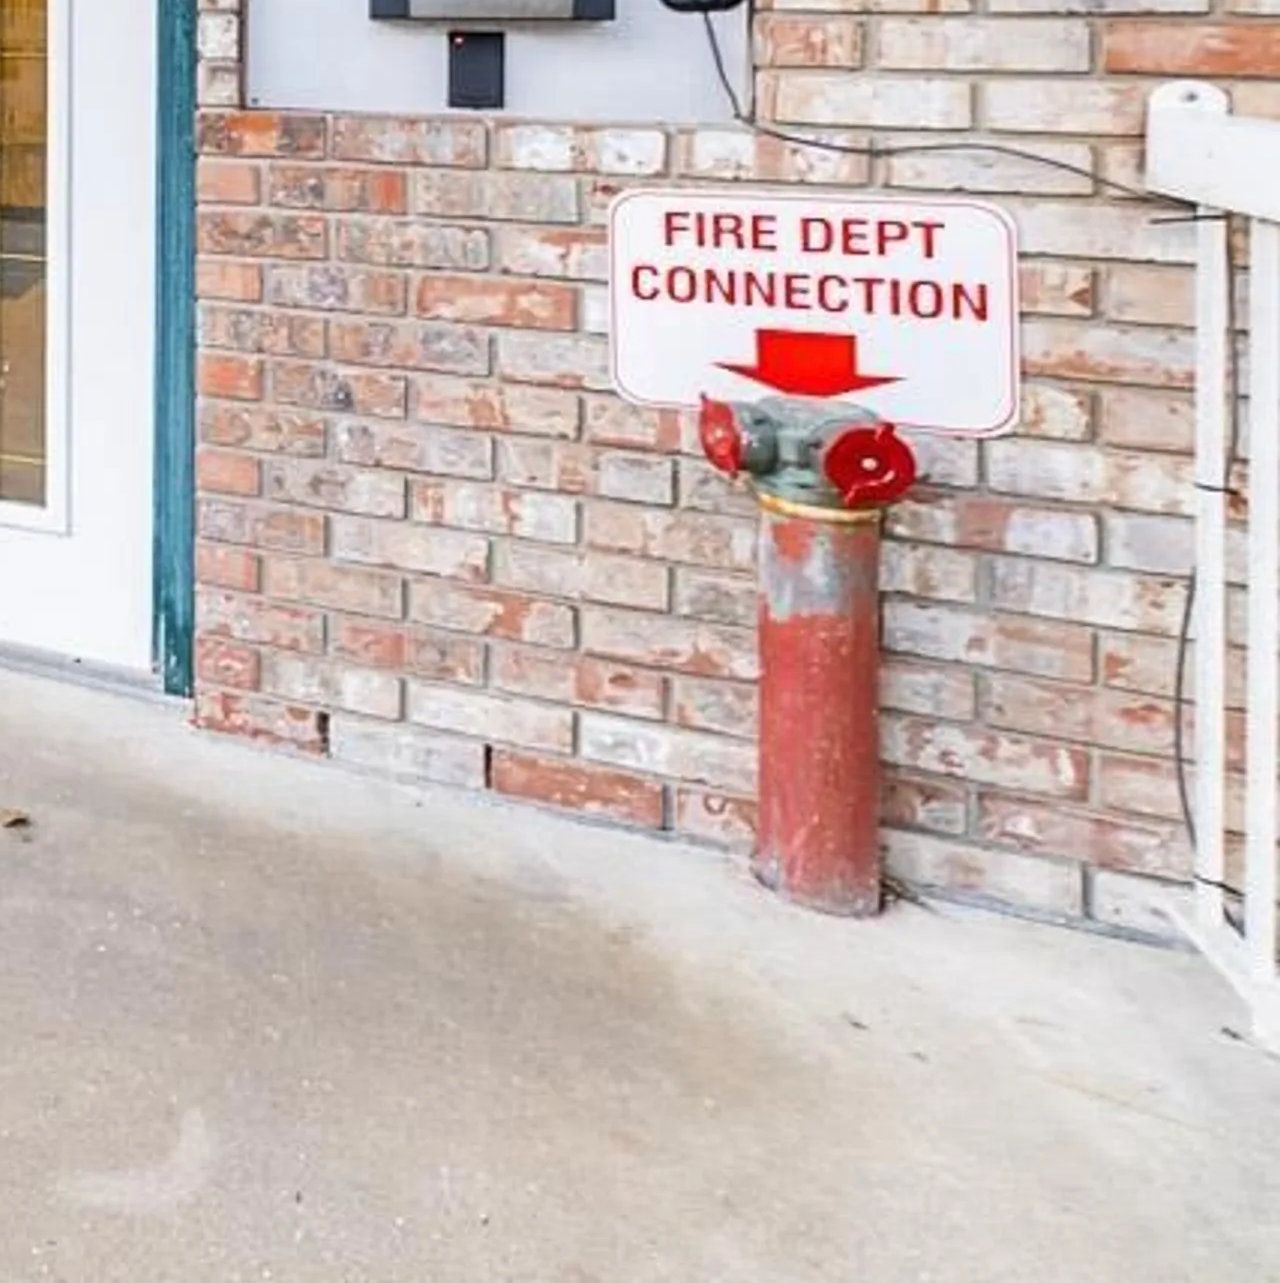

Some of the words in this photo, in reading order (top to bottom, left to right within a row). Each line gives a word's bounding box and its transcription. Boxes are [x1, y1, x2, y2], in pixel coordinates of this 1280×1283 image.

[662, 211, 778, 252] FIRE
[800, 216, 945, 259] DEPT
[631, 264, 989, 322] CONNECTION
